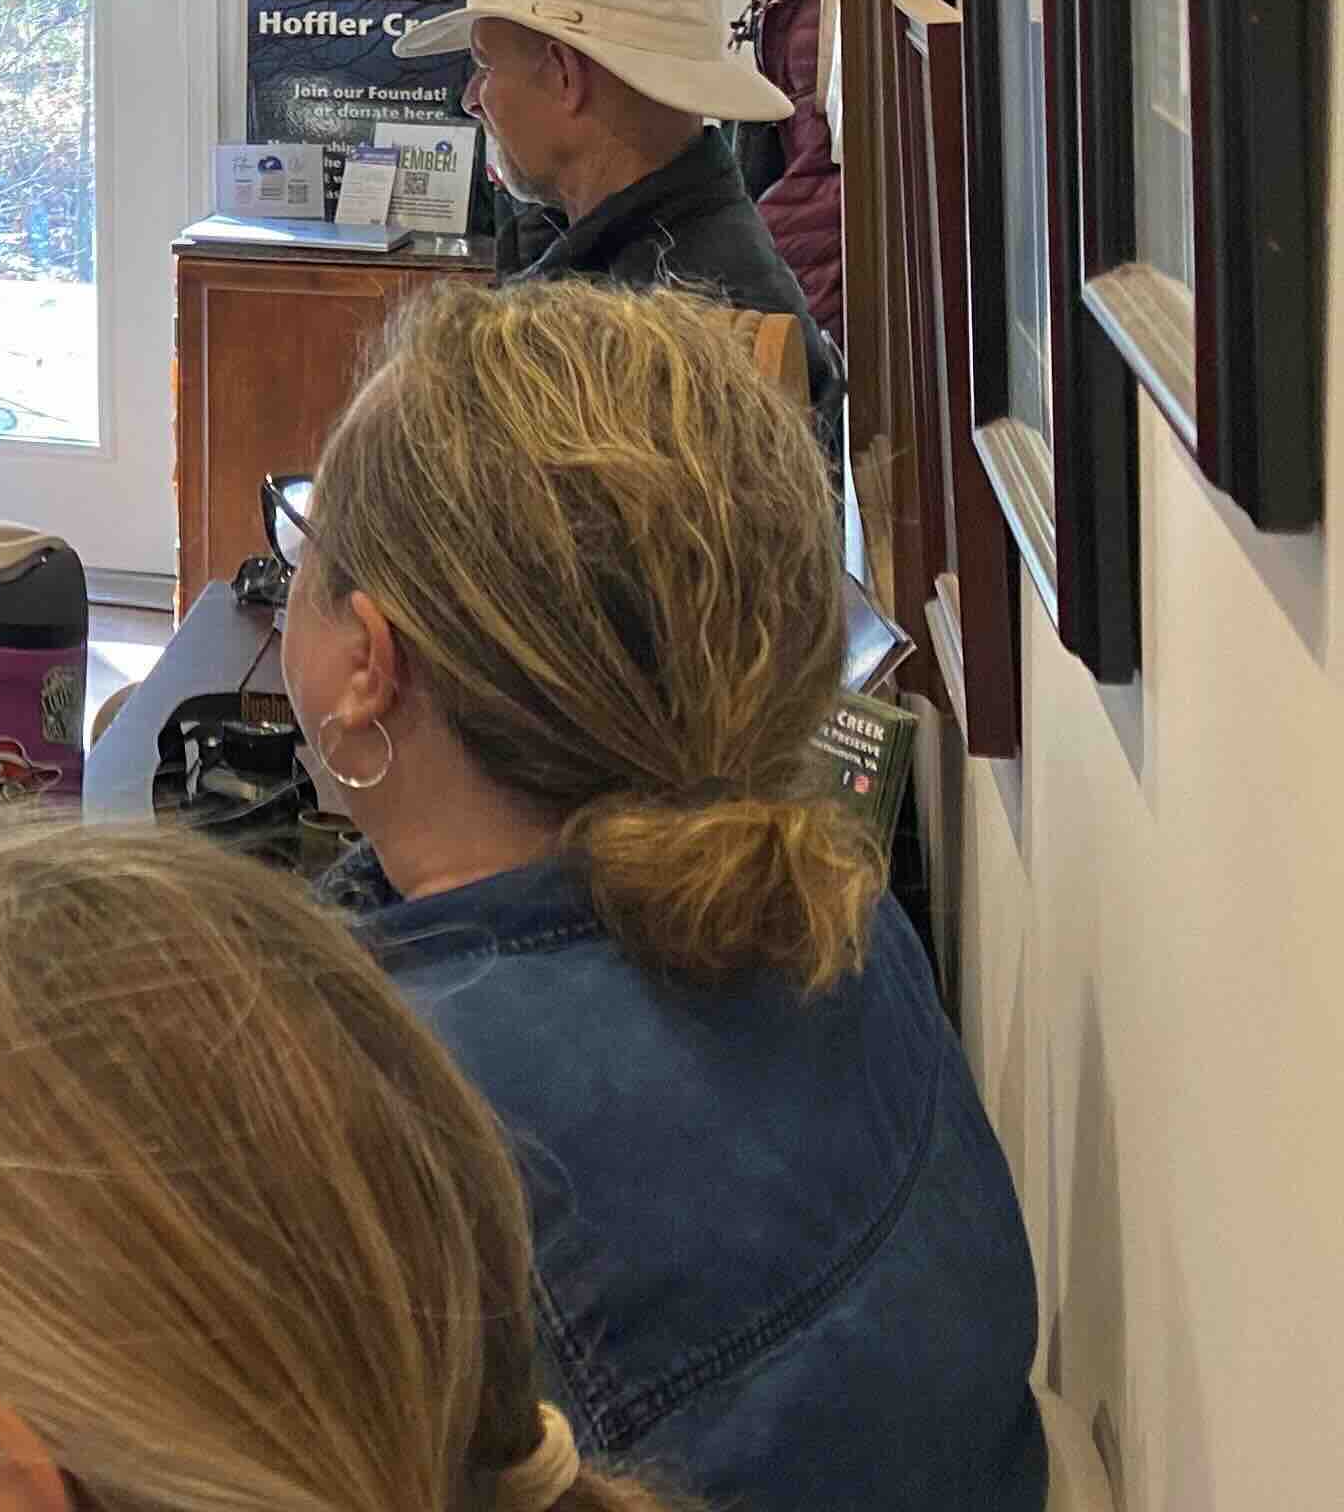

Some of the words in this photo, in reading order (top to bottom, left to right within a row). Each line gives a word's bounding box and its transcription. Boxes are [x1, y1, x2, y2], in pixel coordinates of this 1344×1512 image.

[258, 11, 374, 36] Hoffler
[382, 12, 423, 36] Cr
[294, 82, 328, 99] Join
[334, 88, 364, 99] our
[368, 86, 448, 101] Foundati
[337, 104, 400, 120] donate
[403, 106, 448, 120] here.
[399, 151, 458, 172] EMBER!
[836, 710, 884, 742] CREEK
